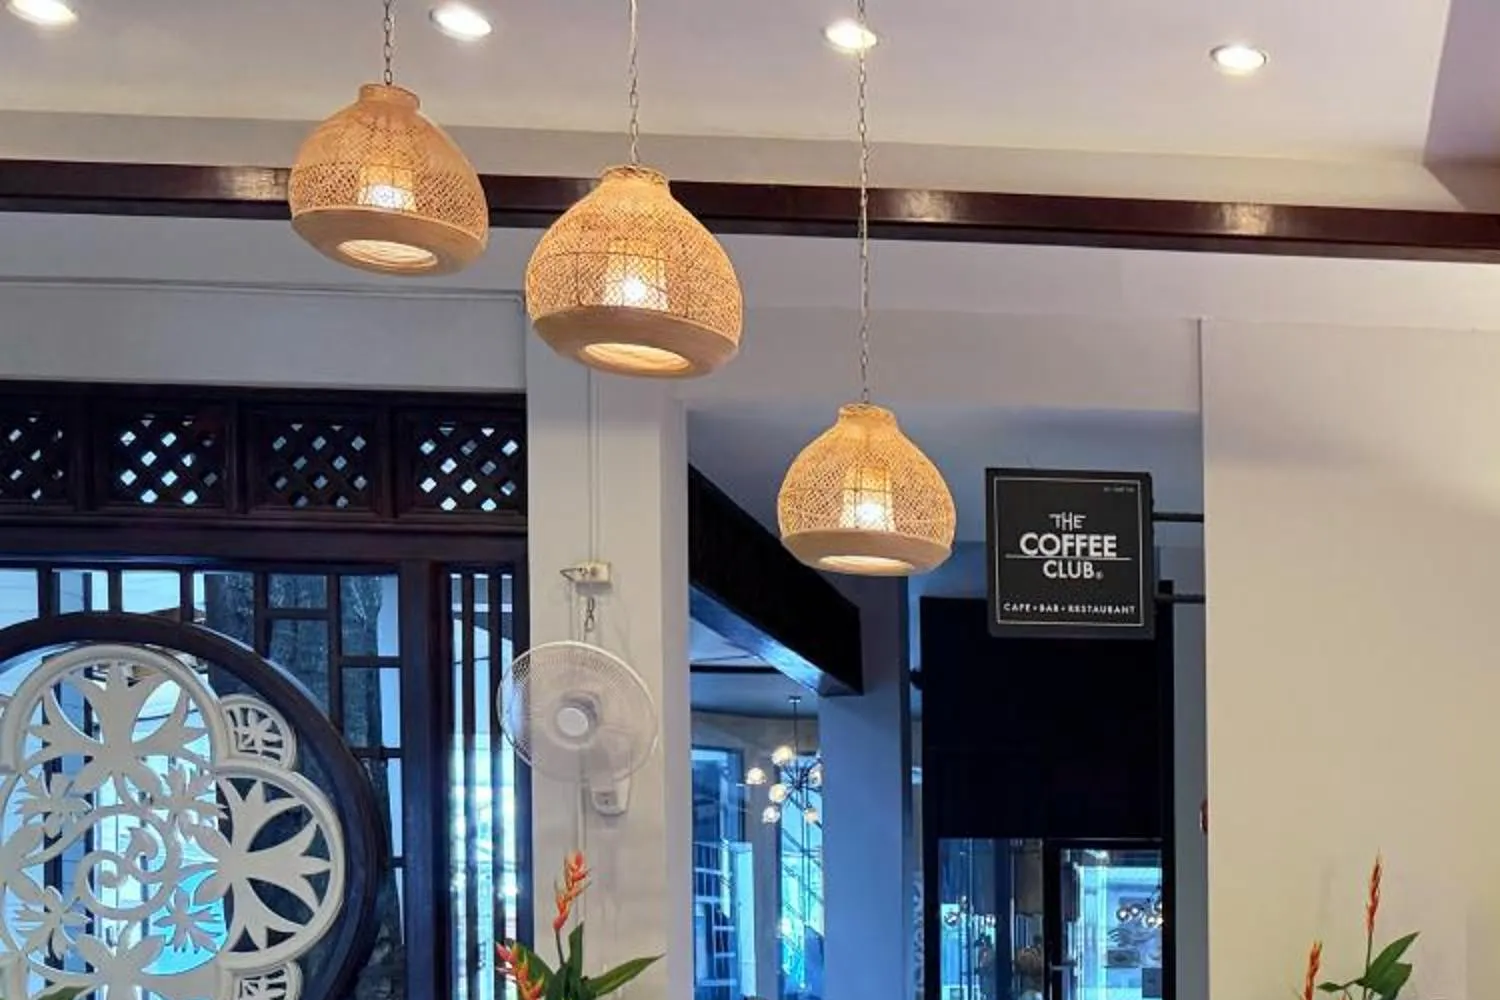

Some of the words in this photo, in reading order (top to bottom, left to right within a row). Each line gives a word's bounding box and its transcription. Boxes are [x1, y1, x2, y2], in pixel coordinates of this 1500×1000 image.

[1048, 511, 1087, 531] THE
[1019, 532, 1118, 557] COFFEE
[1043, 560, 1095, 579] CLUB
[1003, 603, 1031, 613] CAFE
[1039, 603, 1060, 613] BAR
[1068, 604, 1136, 614] RESTAURANT
